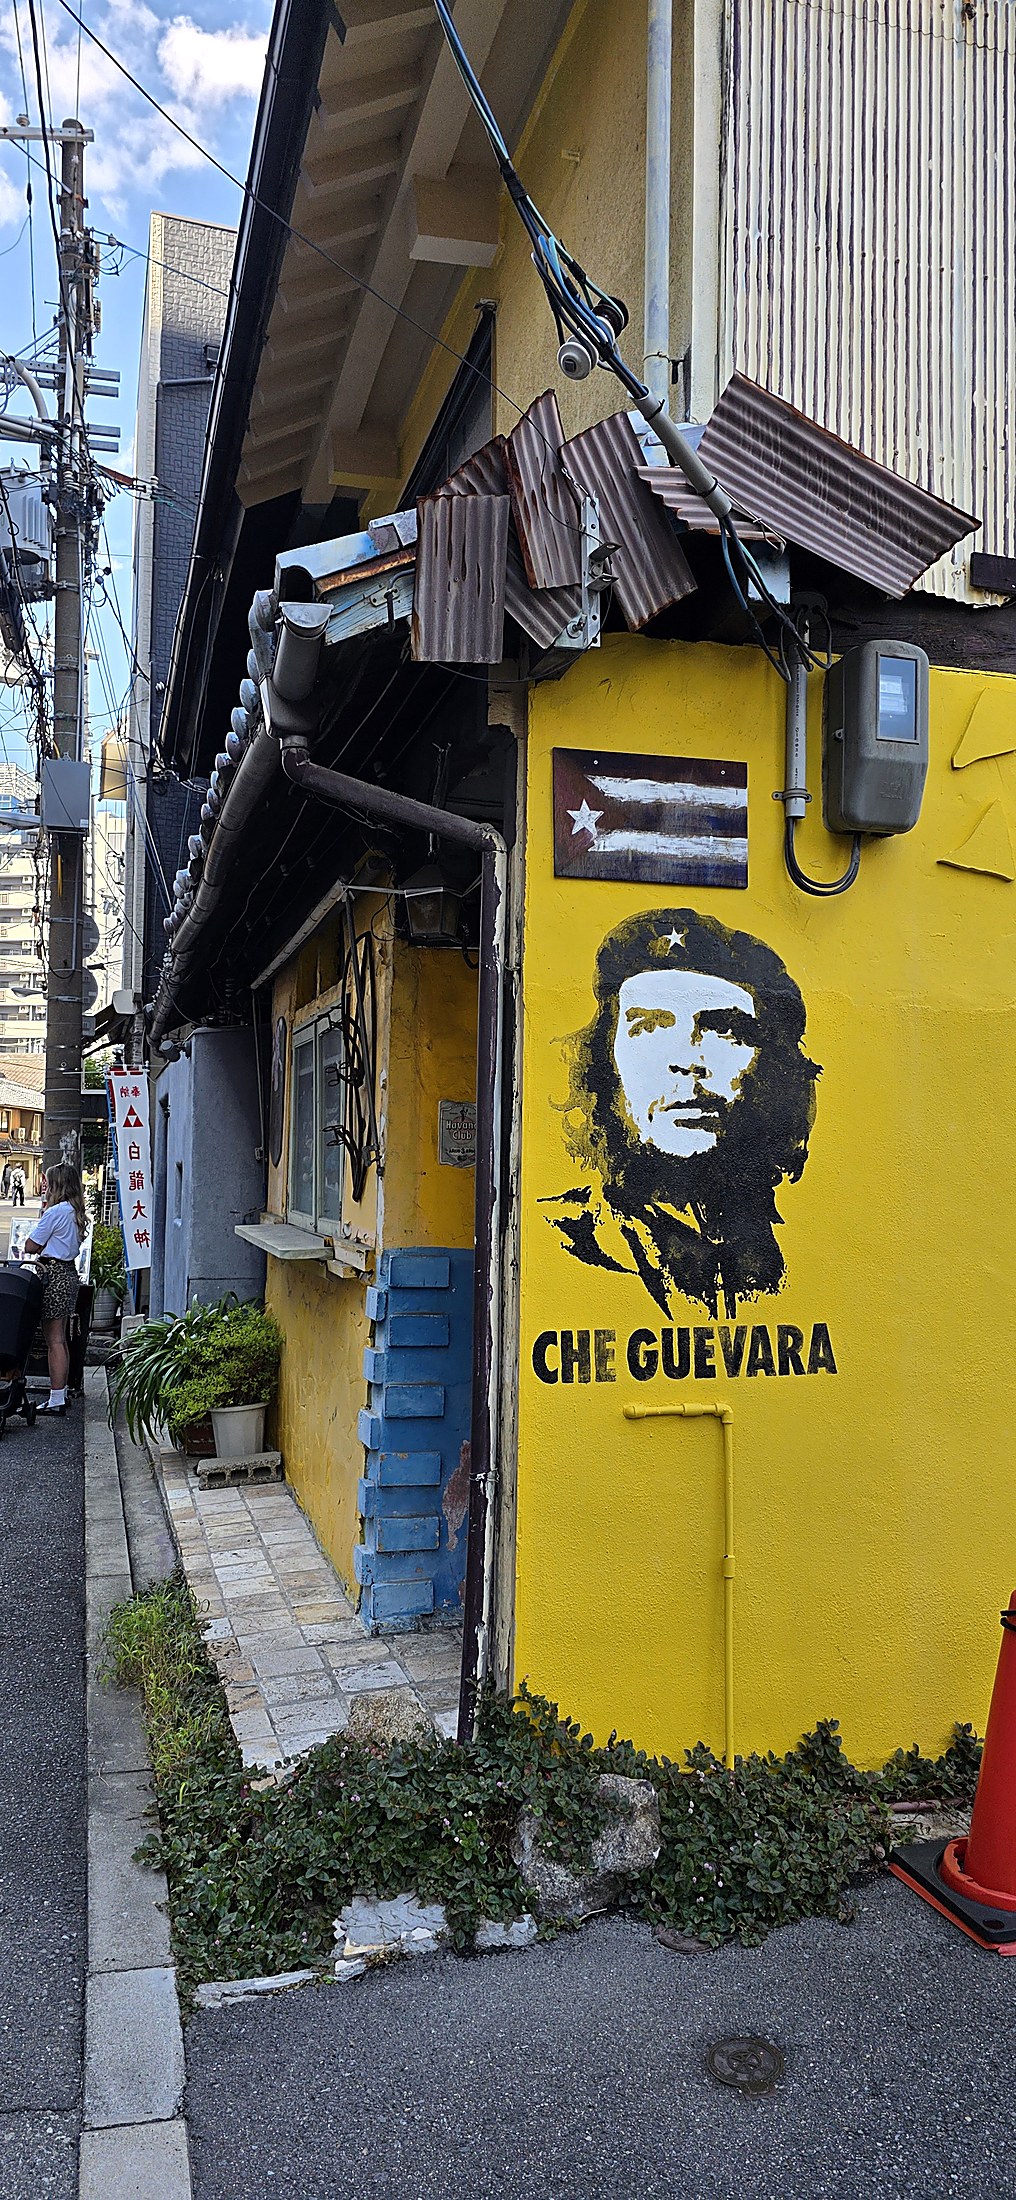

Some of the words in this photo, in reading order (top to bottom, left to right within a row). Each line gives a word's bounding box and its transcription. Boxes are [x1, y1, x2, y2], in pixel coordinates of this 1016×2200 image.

[452, 1130, 472, 1140] Club
[532, 1329, 616, 1384] CHE
[627, 1323, 838, 1381] GUEVARA
